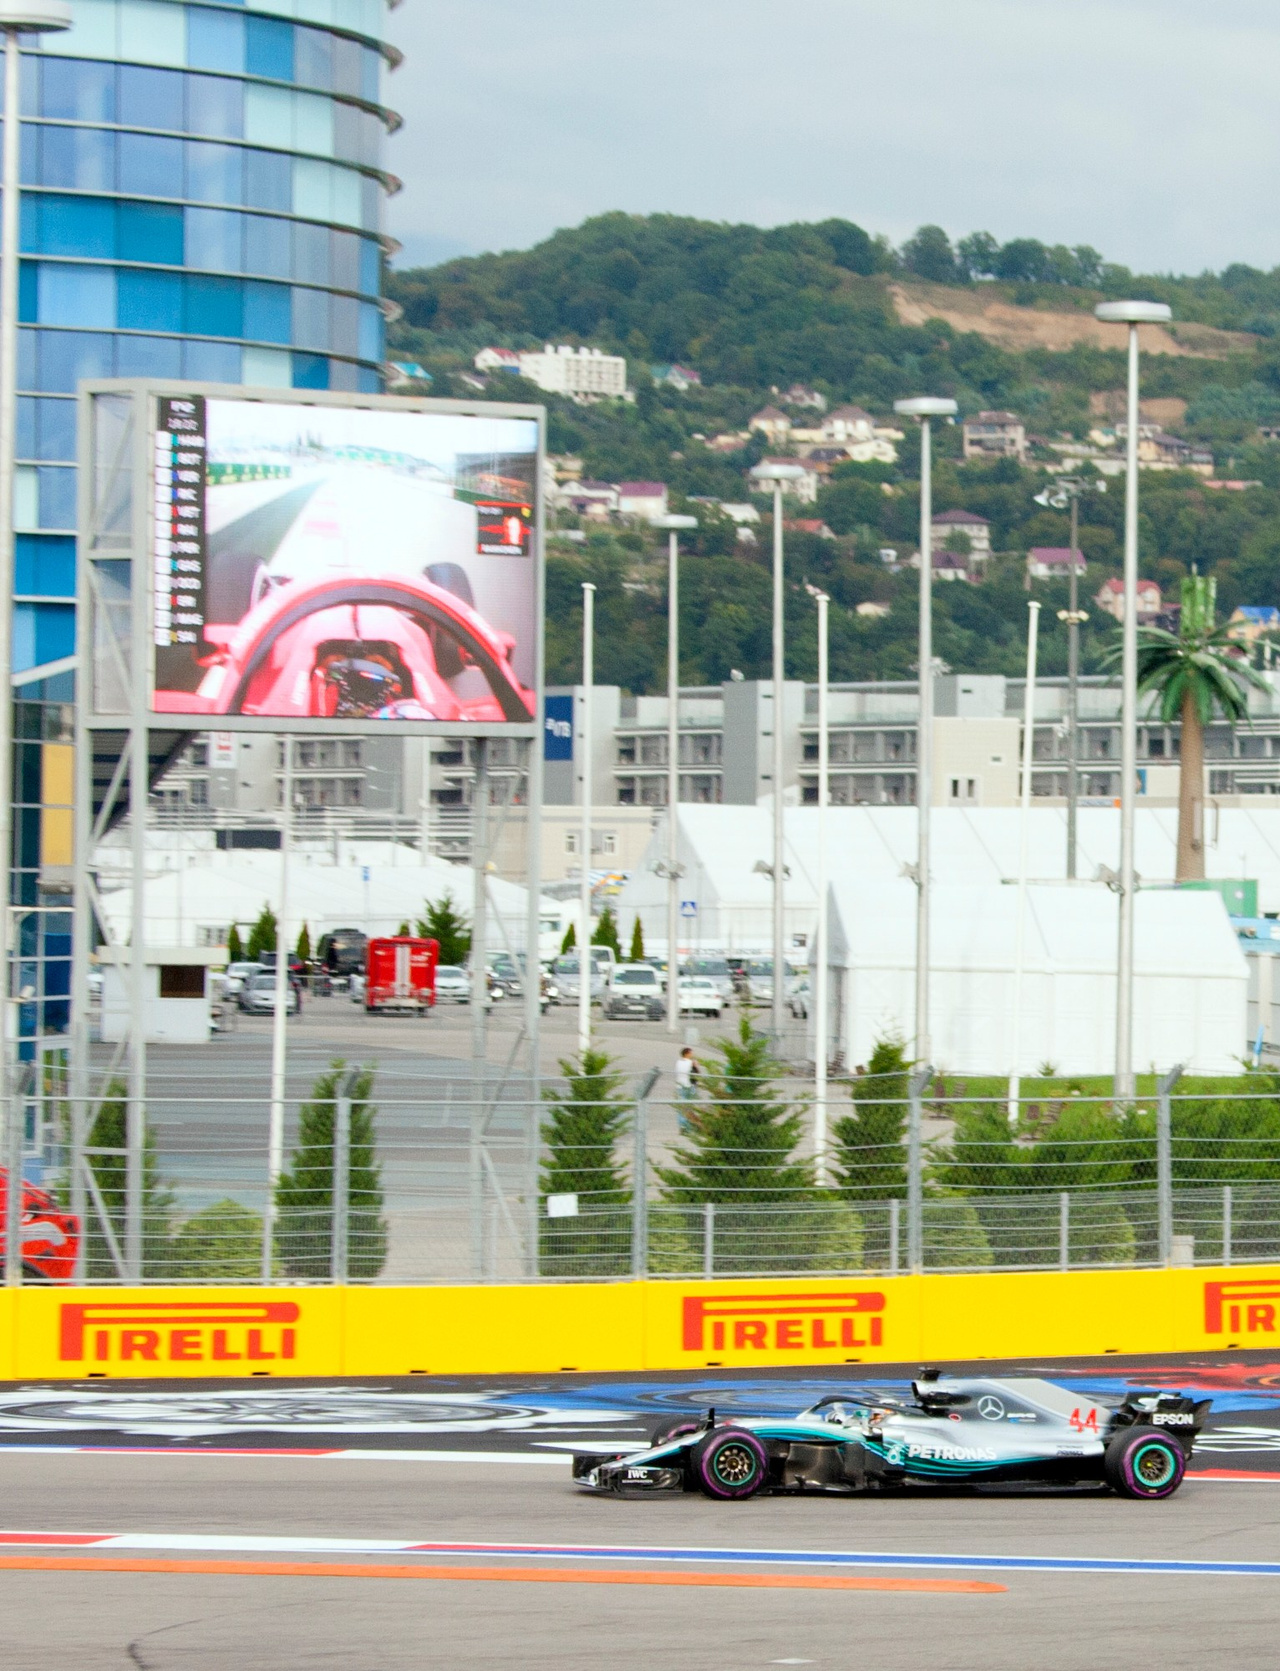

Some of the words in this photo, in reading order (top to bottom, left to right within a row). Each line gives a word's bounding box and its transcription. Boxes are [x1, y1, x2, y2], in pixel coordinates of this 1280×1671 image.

[59, 1301, 300, 1361] PIRELLI
[683, 1292, 886, 1351] PIRELLI
[1069, 1408, 1100, 1434] 44
[1153, 1413, 1194, 1425] EPSON
[908, 1444, 997, 1460] PETRONAS
[627, 1469, 648, 1479] IWC
